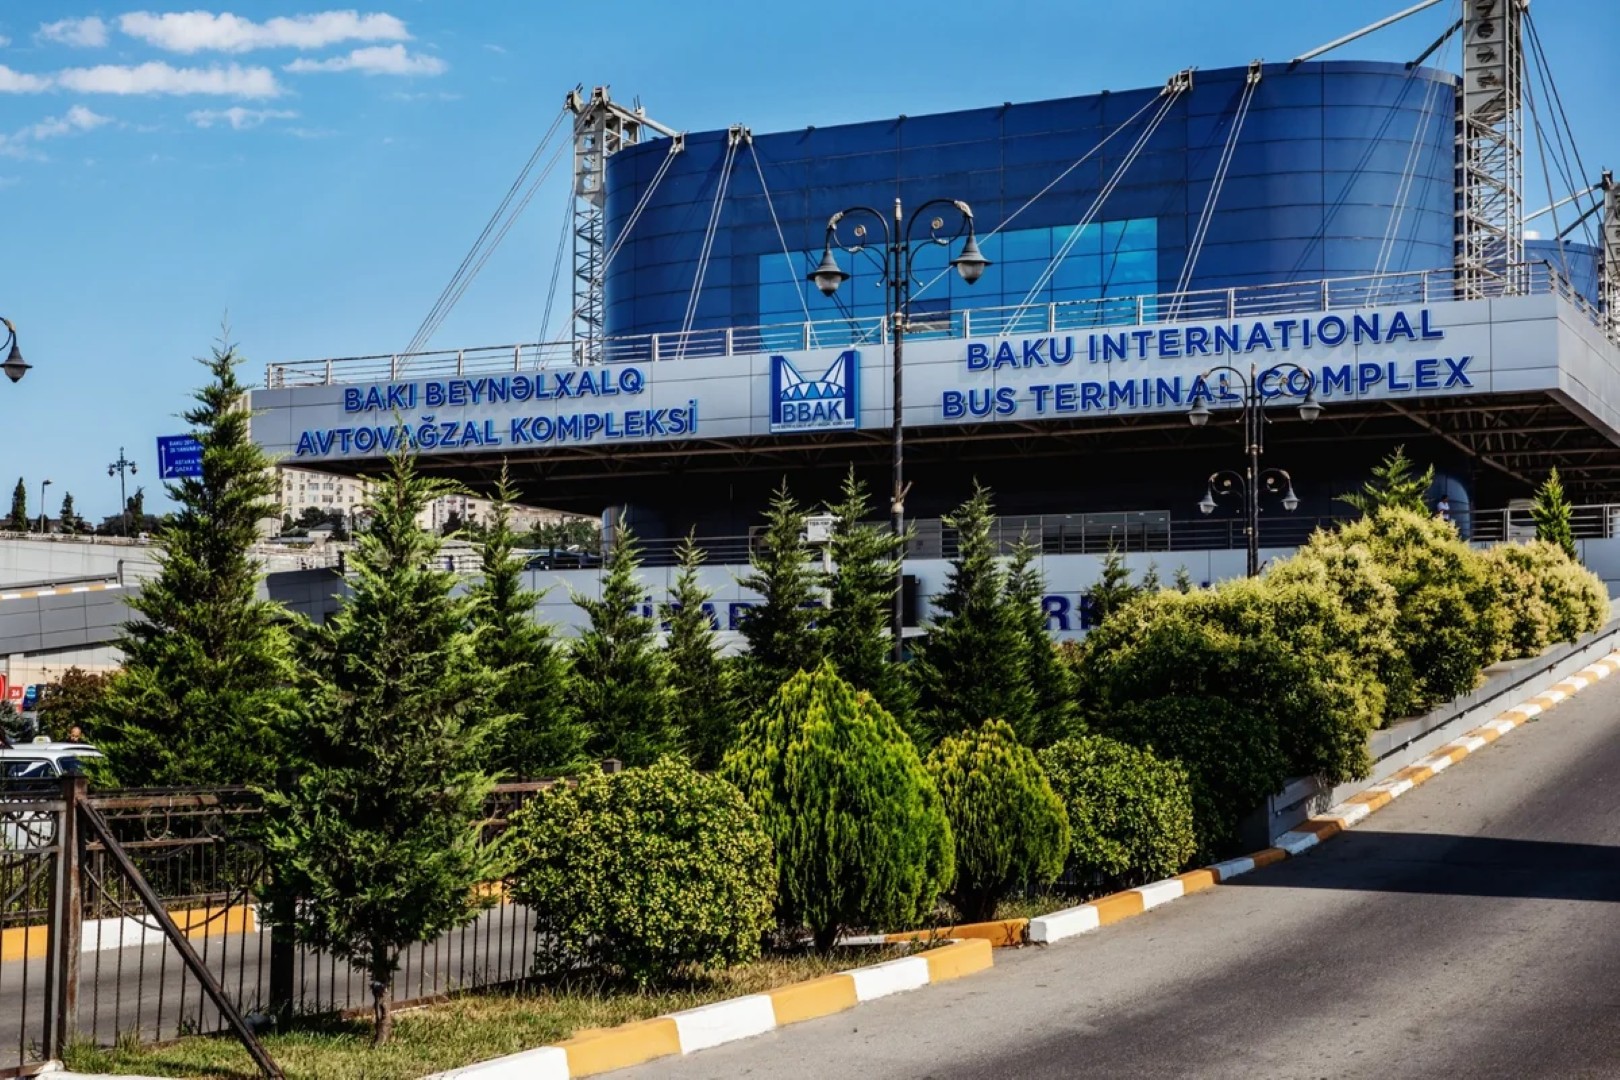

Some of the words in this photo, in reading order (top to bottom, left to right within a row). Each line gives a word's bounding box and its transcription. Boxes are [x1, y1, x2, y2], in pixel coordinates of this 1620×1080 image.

[966, 336, 1073, 371] BAKU
[1088, 309, 1443, 362] INTERNATIONAL
[344, 383, 417, 413] BAKI
[425, 368, 645, 407] BEYNƏLXALQ
[783, 401, 842, 423] BBAK
[942, 387, 1016, 417] BUS
[1028, 371, 1240, 412] TERMINAL
[1256, 355, 1473, 398] COMPLEX
[296, 415, 499, 455] AVTOVAĞZAL
[510, 400, 697, 443] KOMPLEKSİ
